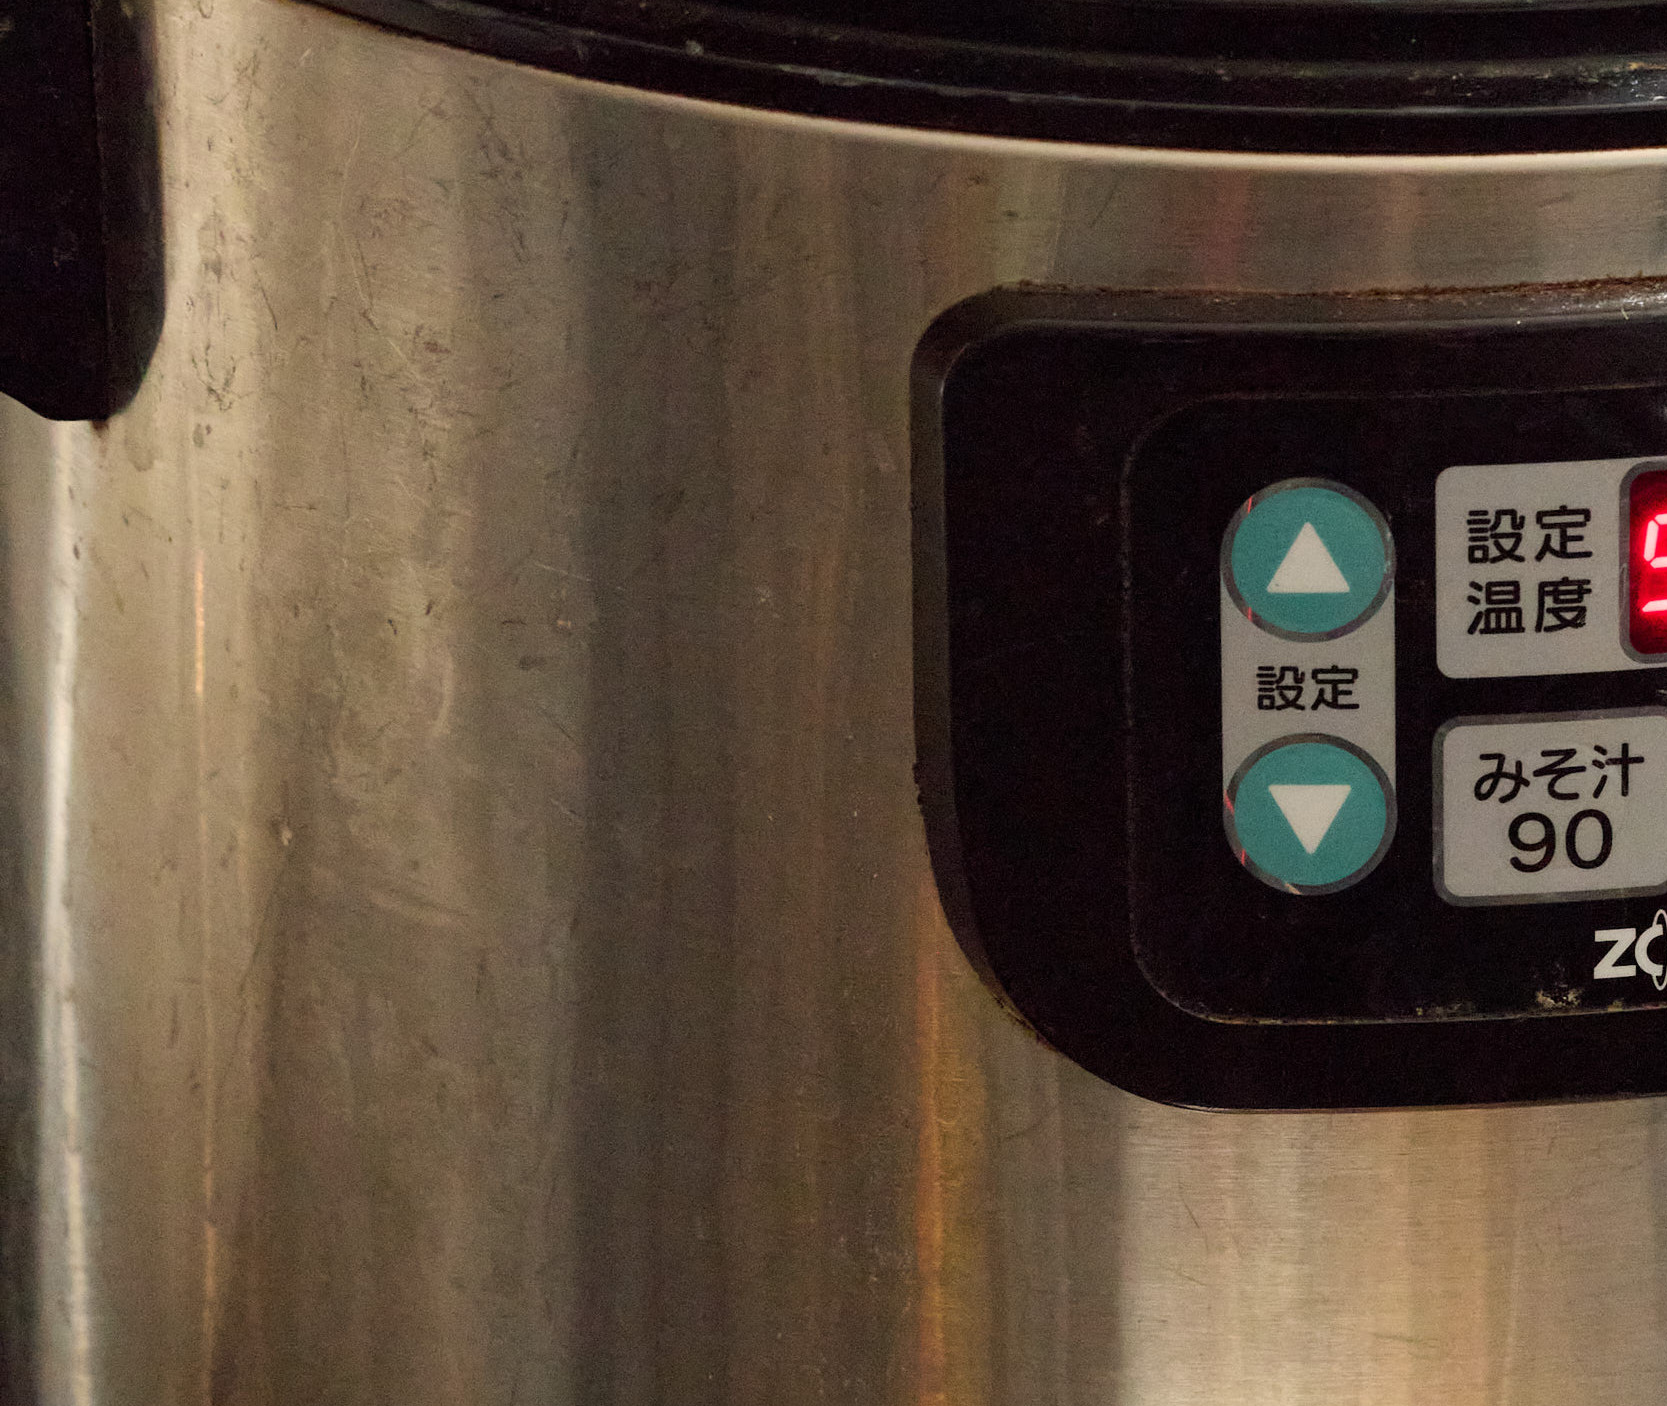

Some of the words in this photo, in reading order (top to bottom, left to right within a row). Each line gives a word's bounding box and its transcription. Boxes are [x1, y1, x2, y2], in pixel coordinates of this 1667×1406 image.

[1466, 505, 1592, 564] 設定
[1466, 577, 1593, 635] 温度
[1256, 665, 1359, 711] 設定
[1473, 742, 1645, 803] みそ汁
[1508, 809, 1613, 873] 90
